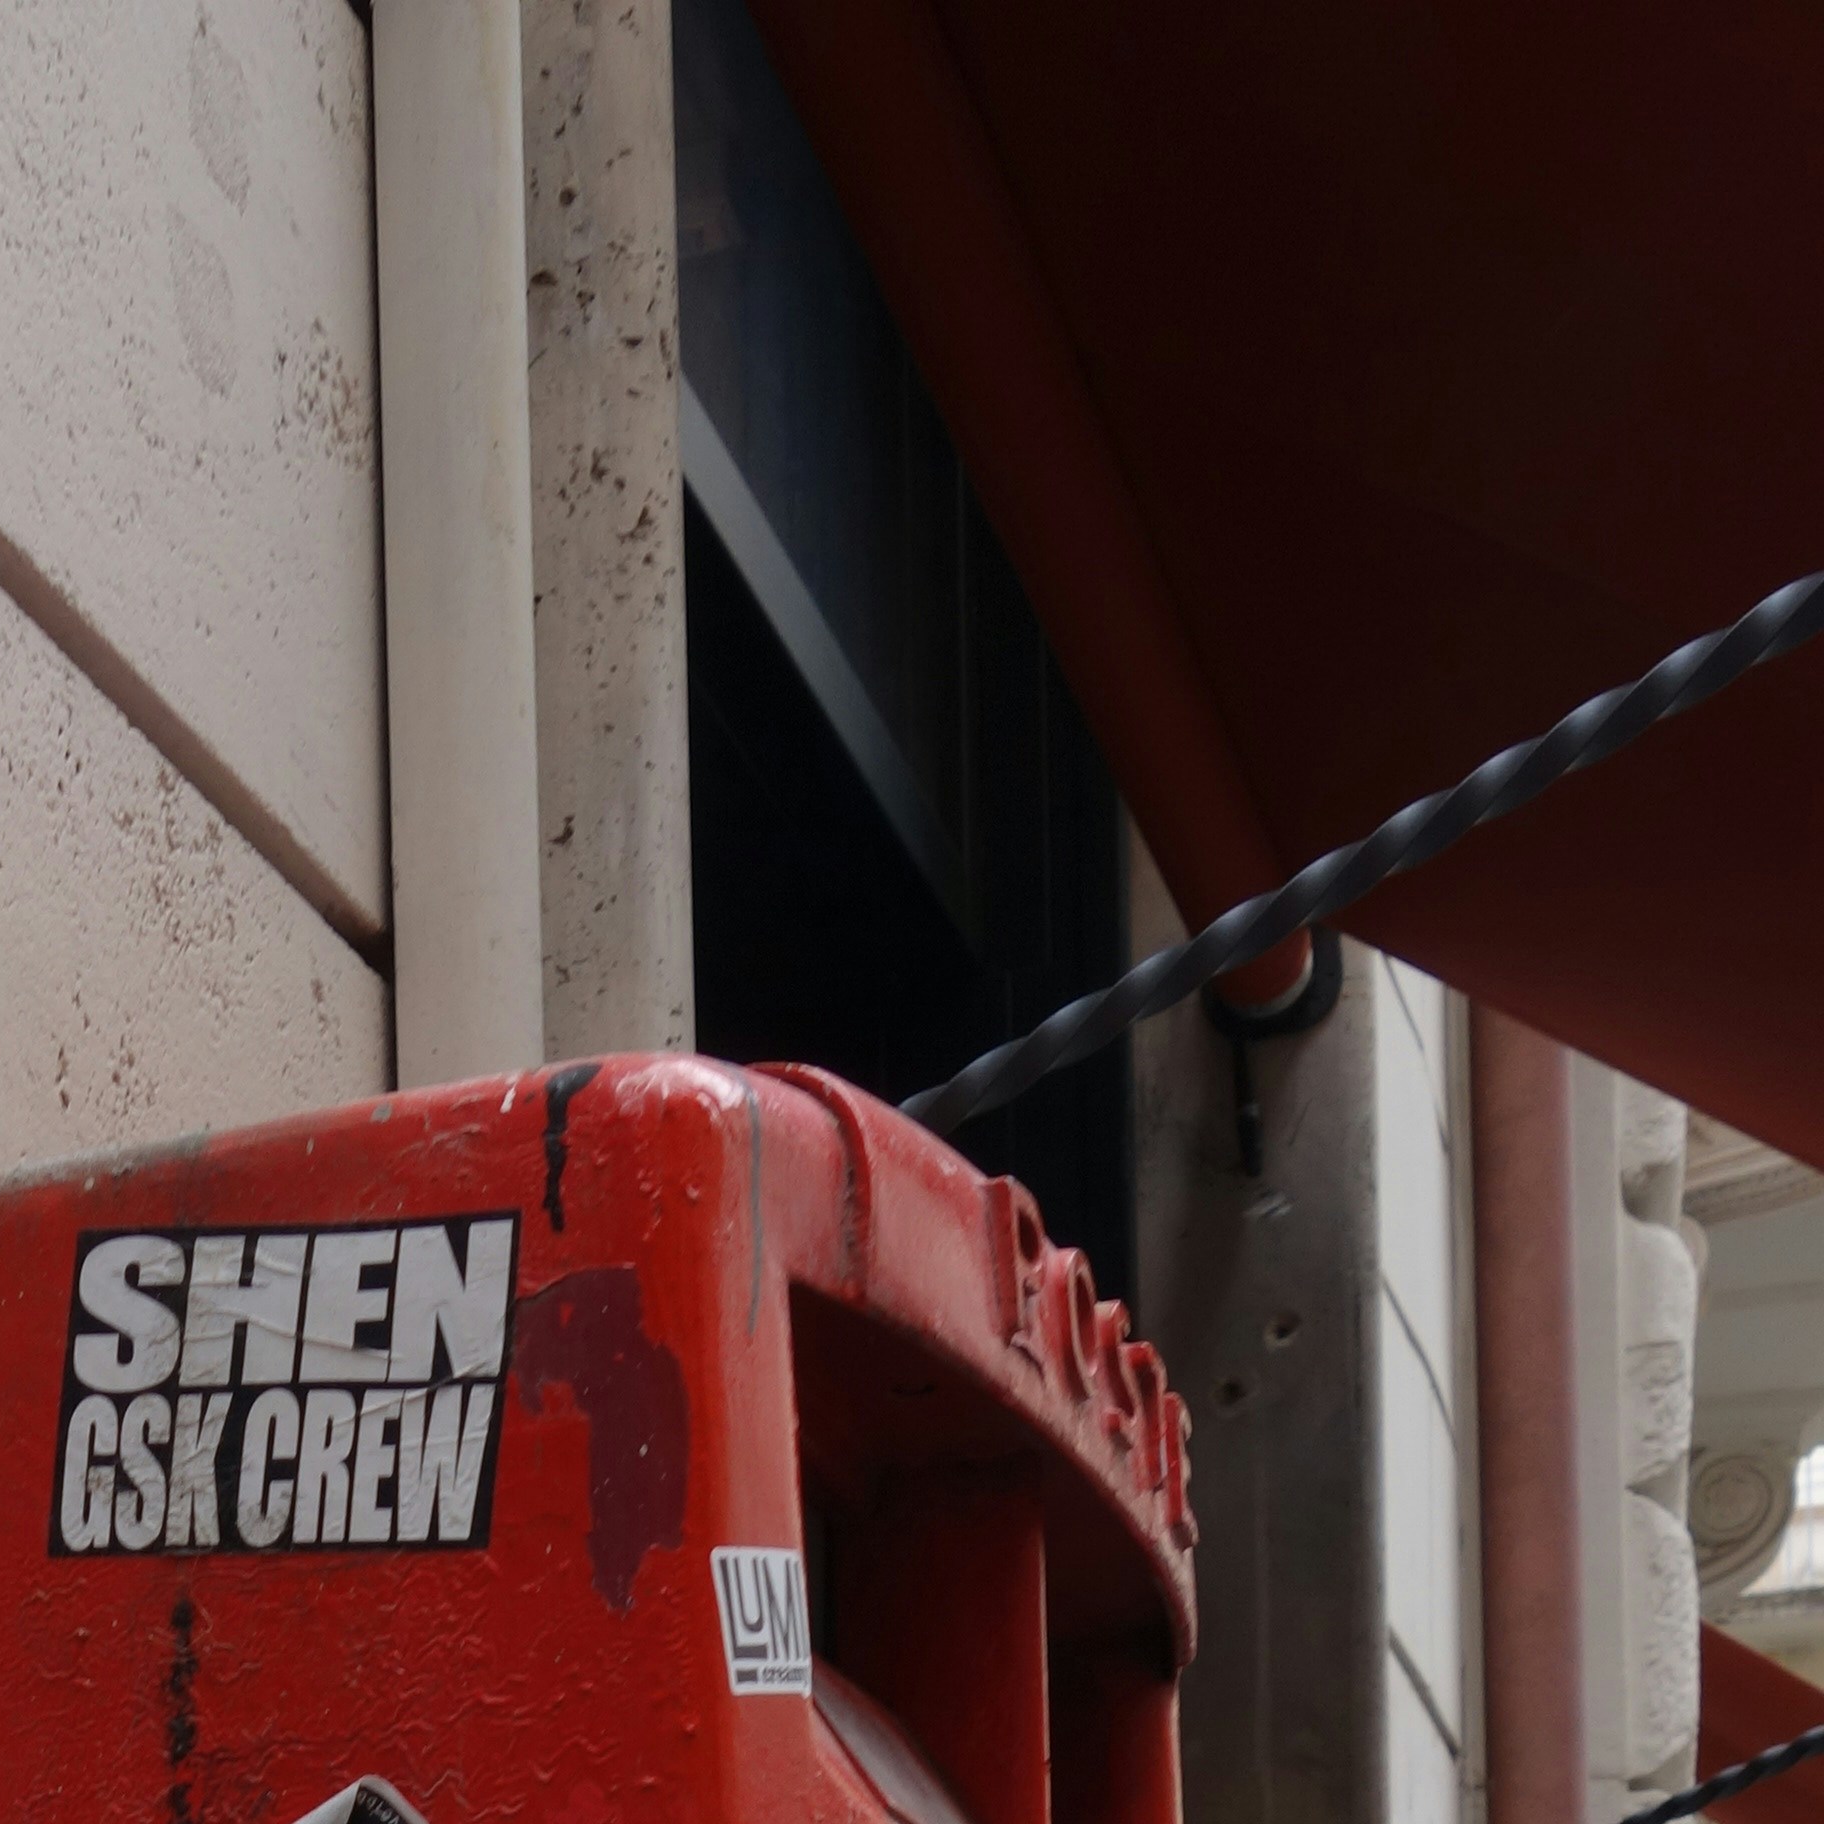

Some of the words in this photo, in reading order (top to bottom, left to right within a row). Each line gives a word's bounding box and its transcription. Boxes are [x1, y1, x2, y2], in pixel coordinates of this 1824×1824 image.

[73, 1218, 514, 1394] SHEN
[60, 1391, 234, 1553] GSK
[235, 1383, 497, 1549] CREW
